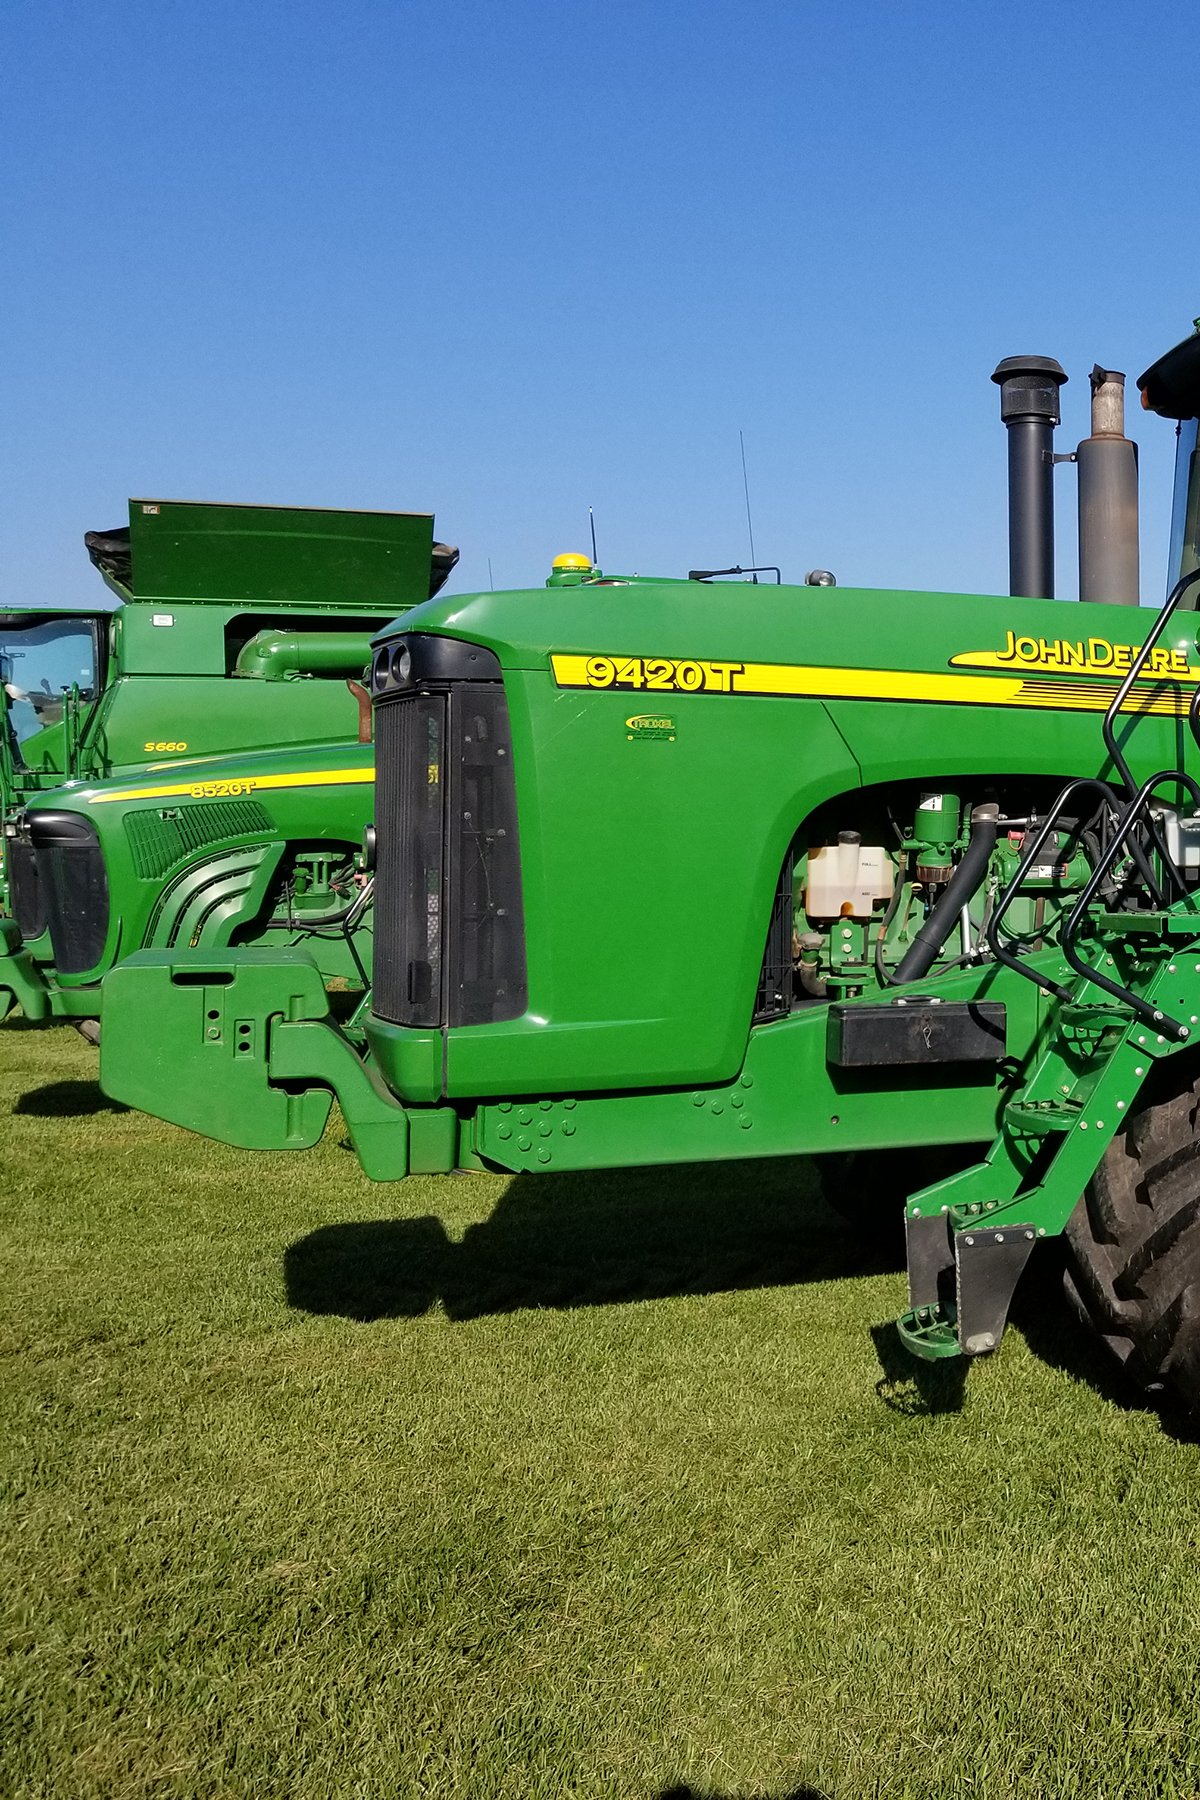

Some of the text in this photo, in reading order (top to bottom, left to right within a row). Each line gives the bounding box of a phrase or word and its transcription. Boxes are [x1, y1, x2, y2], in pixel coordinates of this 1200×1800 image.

[996, 631, 1086, 665] JOHN
[586, 656, 745, 692] 9420T
[143, 742, 187, 752] S660
[190, 781, 256, 799] 8520T
